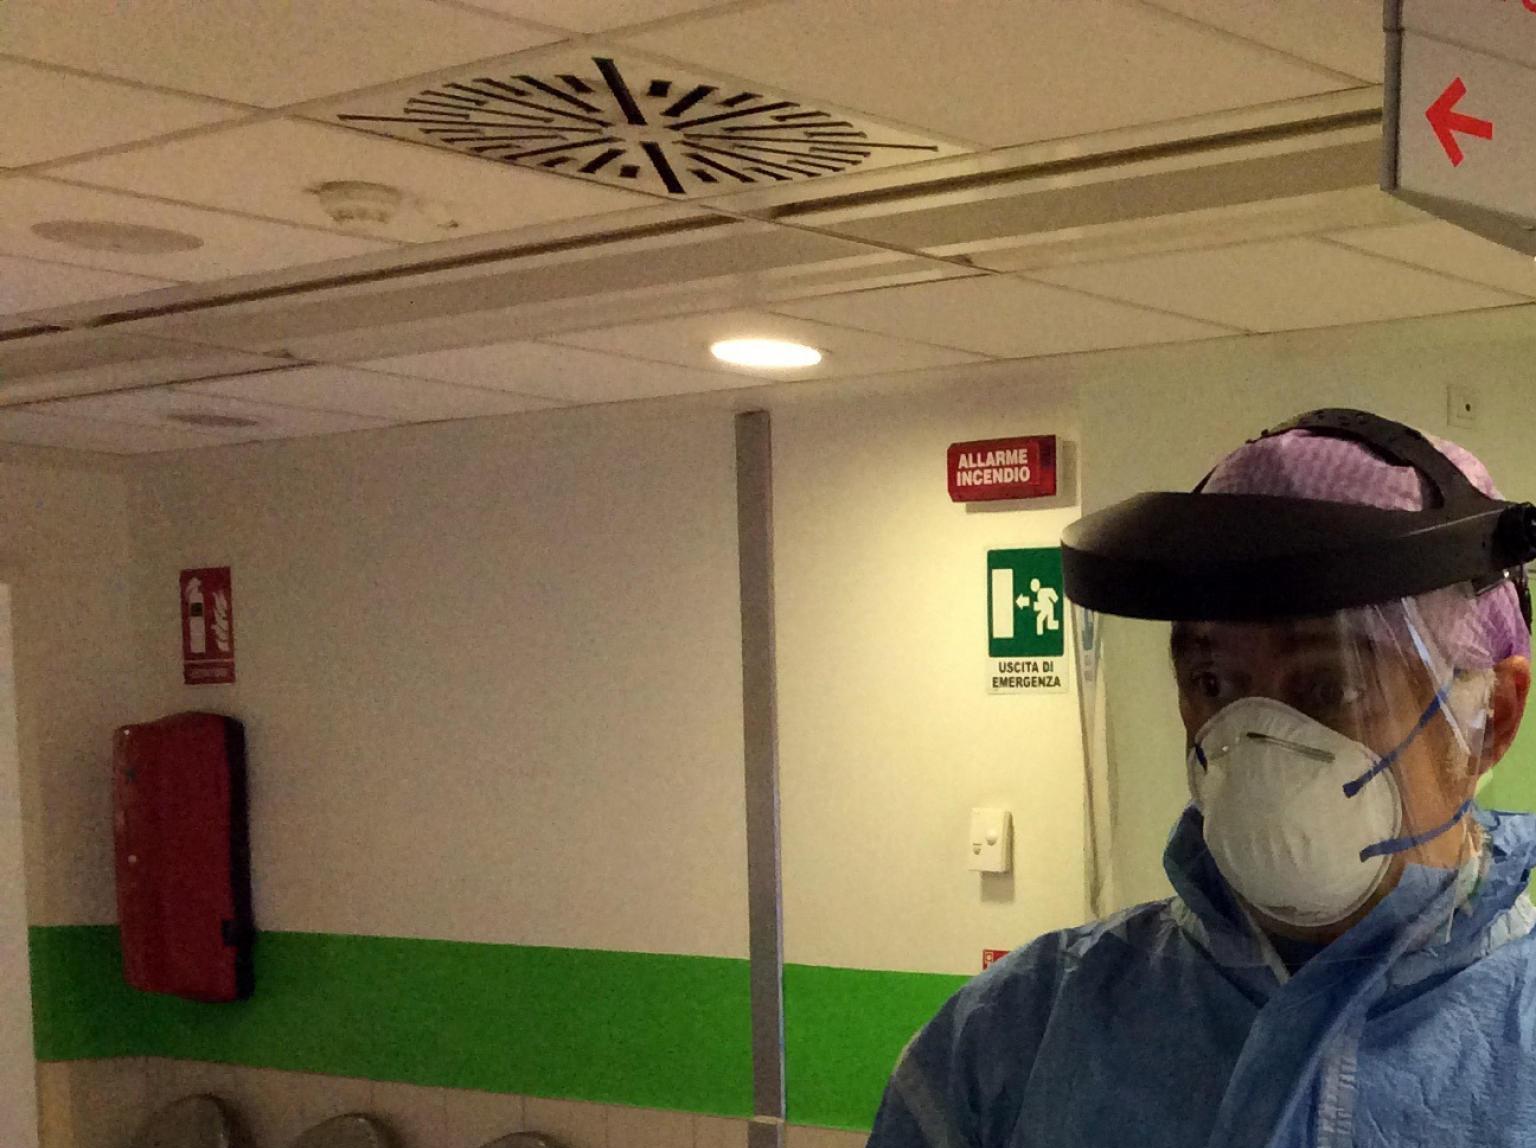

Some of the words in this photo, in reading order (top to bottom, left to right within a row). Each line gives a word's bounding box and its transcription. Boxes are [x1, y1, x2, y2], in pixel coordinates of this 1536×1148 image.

[958, 448, 1028, 469] ALLARME
[956, 466, 1031, 487] INCENDIO
[998, 661, 1039, 673] USCITA
[1043, 661, 1054, 672] DI
[992, 676, 1062, 688] EMERGENZA
